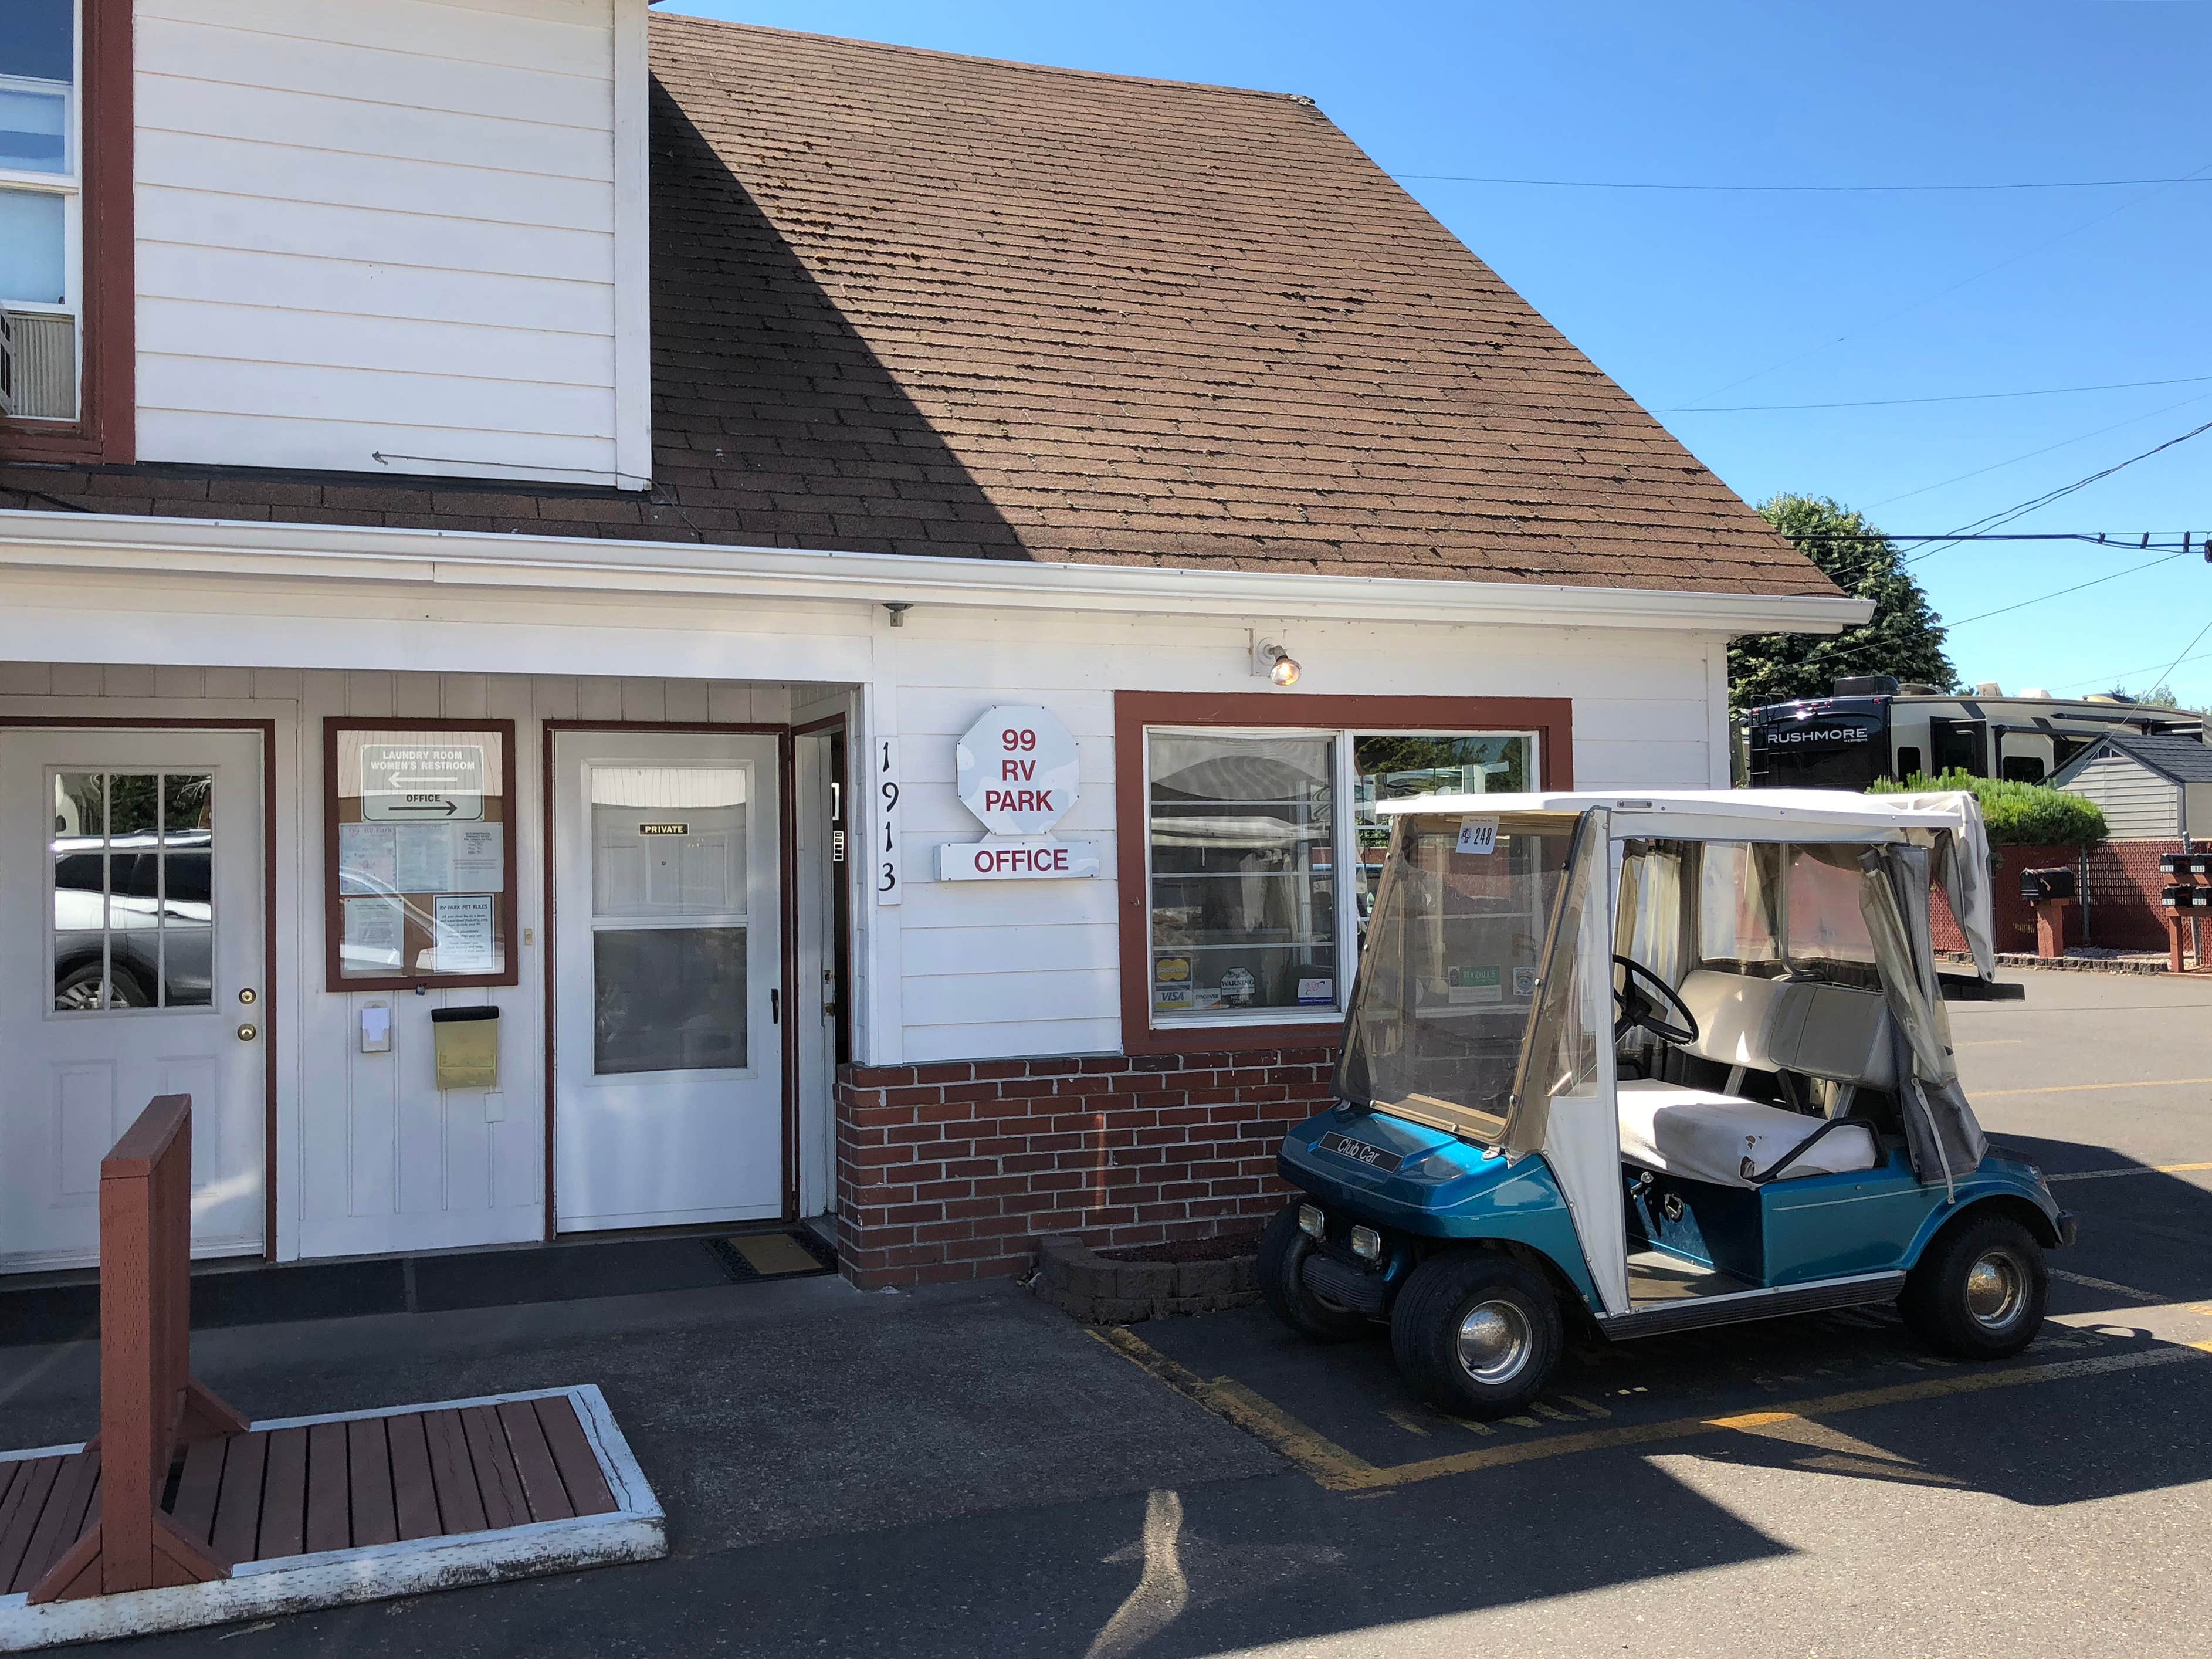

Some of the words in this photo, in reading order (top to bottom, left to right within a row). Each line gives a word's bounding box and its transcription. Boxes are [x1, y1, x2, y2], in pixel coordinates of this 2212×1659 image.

[1002, 729, 1036, 751] 99
[1767, 727, 1868, 744] RUSHMORE
[382, 751, 429, 760] LAUNDRY
[433, 751, 463, 760] ROOM
[371, 761, 417, 770] WOMEN'S
[421, 761, 475, 770] RESTROOM
[1002, 760, 1036, 781] RV
[406, 794, 441, 803] OFFICE
[985, 790, 1054, 812] PARK
[878, 742, 899, 891] 1913
[645, 825, 683, 834] PRIVATE
[1473, 827, 1492, 845] 248
[974, 848, 1069, 873] OFFICE
[1161, 991, 1184, 1001] VISA
[1337, 1138, 1360, 1156] Club
[1359, 1146, 1380, 1163] Car
